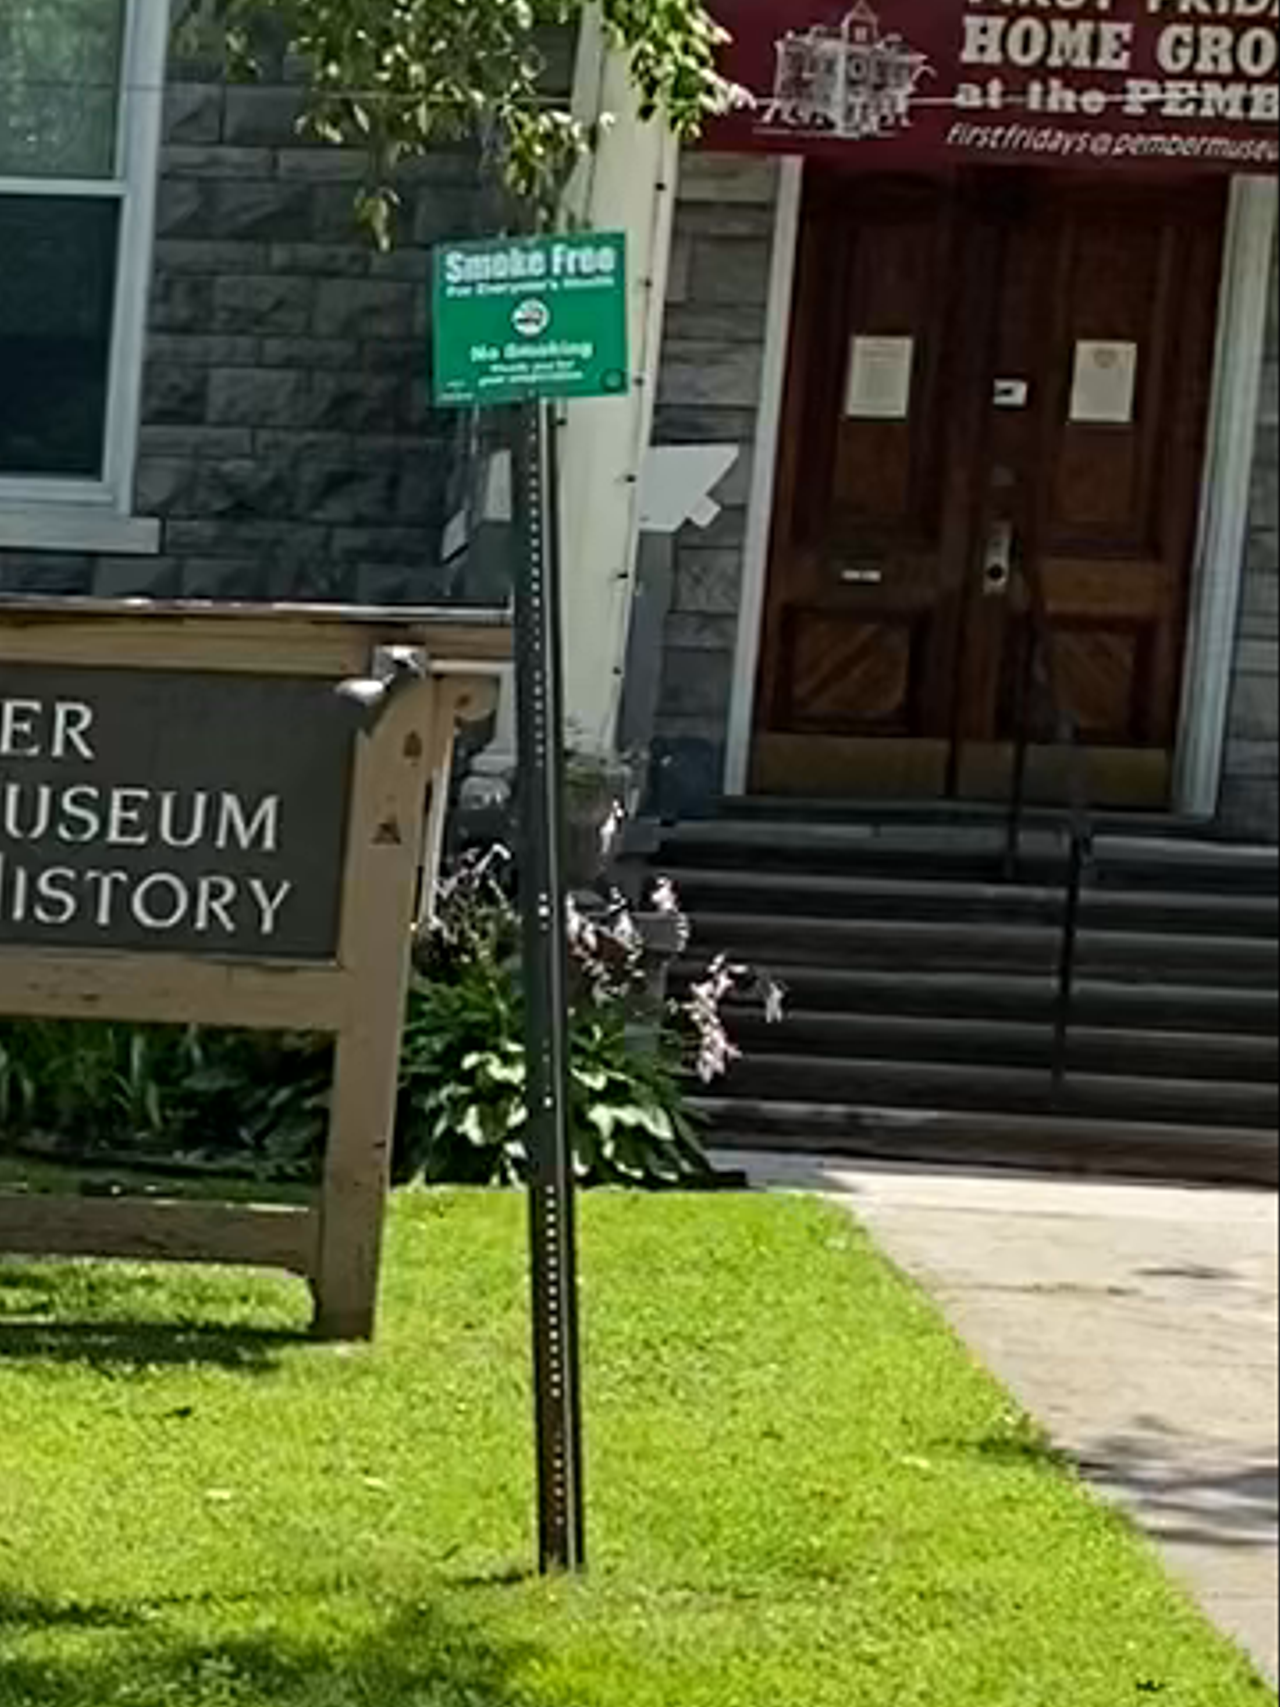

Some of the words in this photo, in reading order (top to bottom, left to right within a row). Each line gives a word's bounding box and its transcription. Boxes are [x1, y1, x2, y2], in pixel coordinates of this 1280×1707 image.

[960, 14, 1133, 71] HOME
[1157, 23, 1277, 76] GRO
[955, 78, 1005, 110] at
[1027, 79, 1107, 114] the
[445, 247, 547, 284] Smoke
[551, 243, 615, 276] Free
